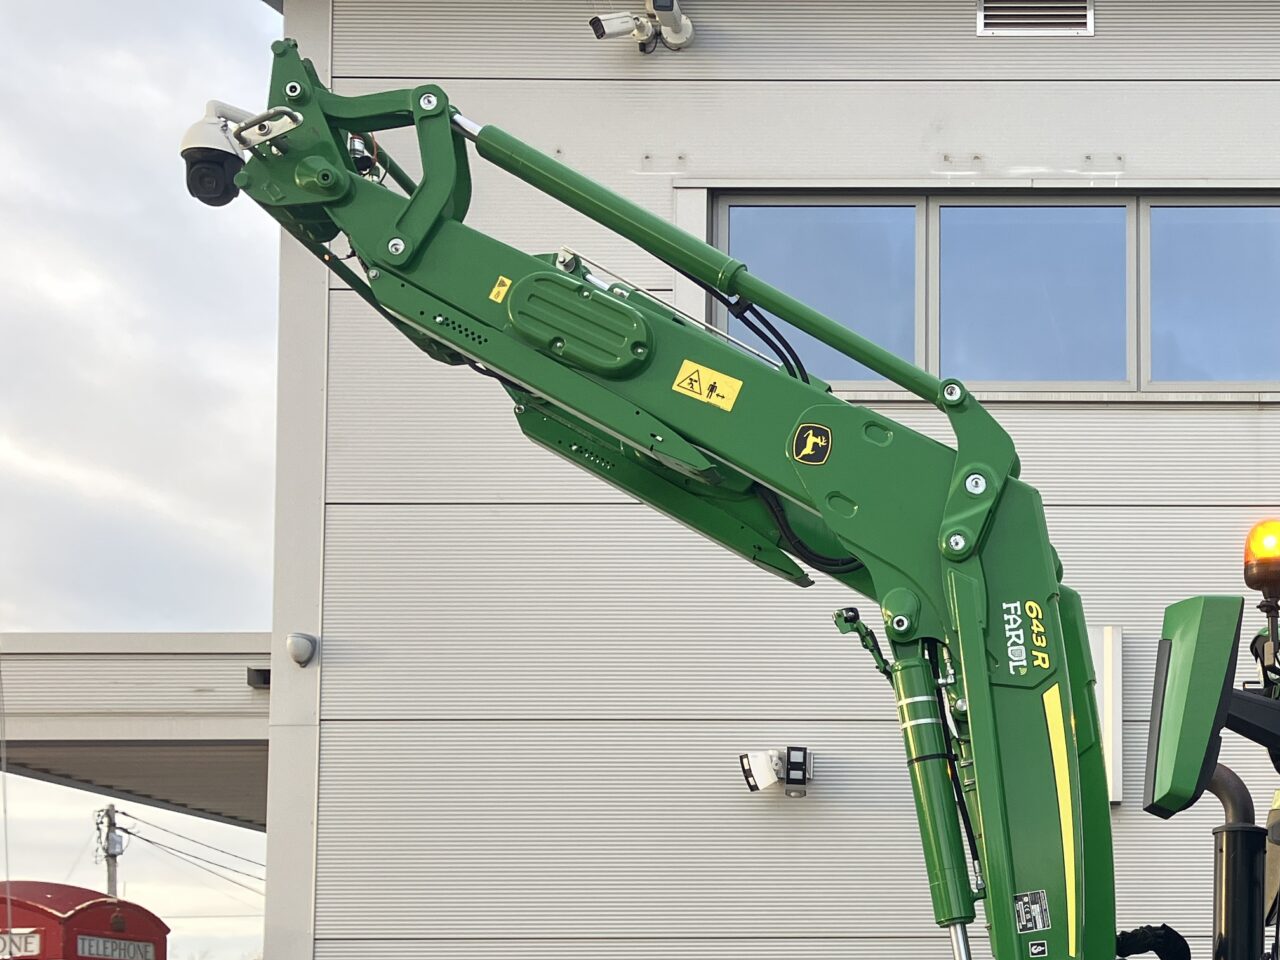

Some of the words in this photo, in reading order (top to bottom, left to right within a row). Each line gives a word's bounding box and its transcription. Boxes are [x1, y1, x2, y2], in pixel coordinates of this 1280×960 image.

[1002, 600, 1028, 676] FAROL
[1024, 600, 1047, 648] 643
[1031, 650, 1050, 670] R
[79, 937, 152, 960] TELEPHONE
